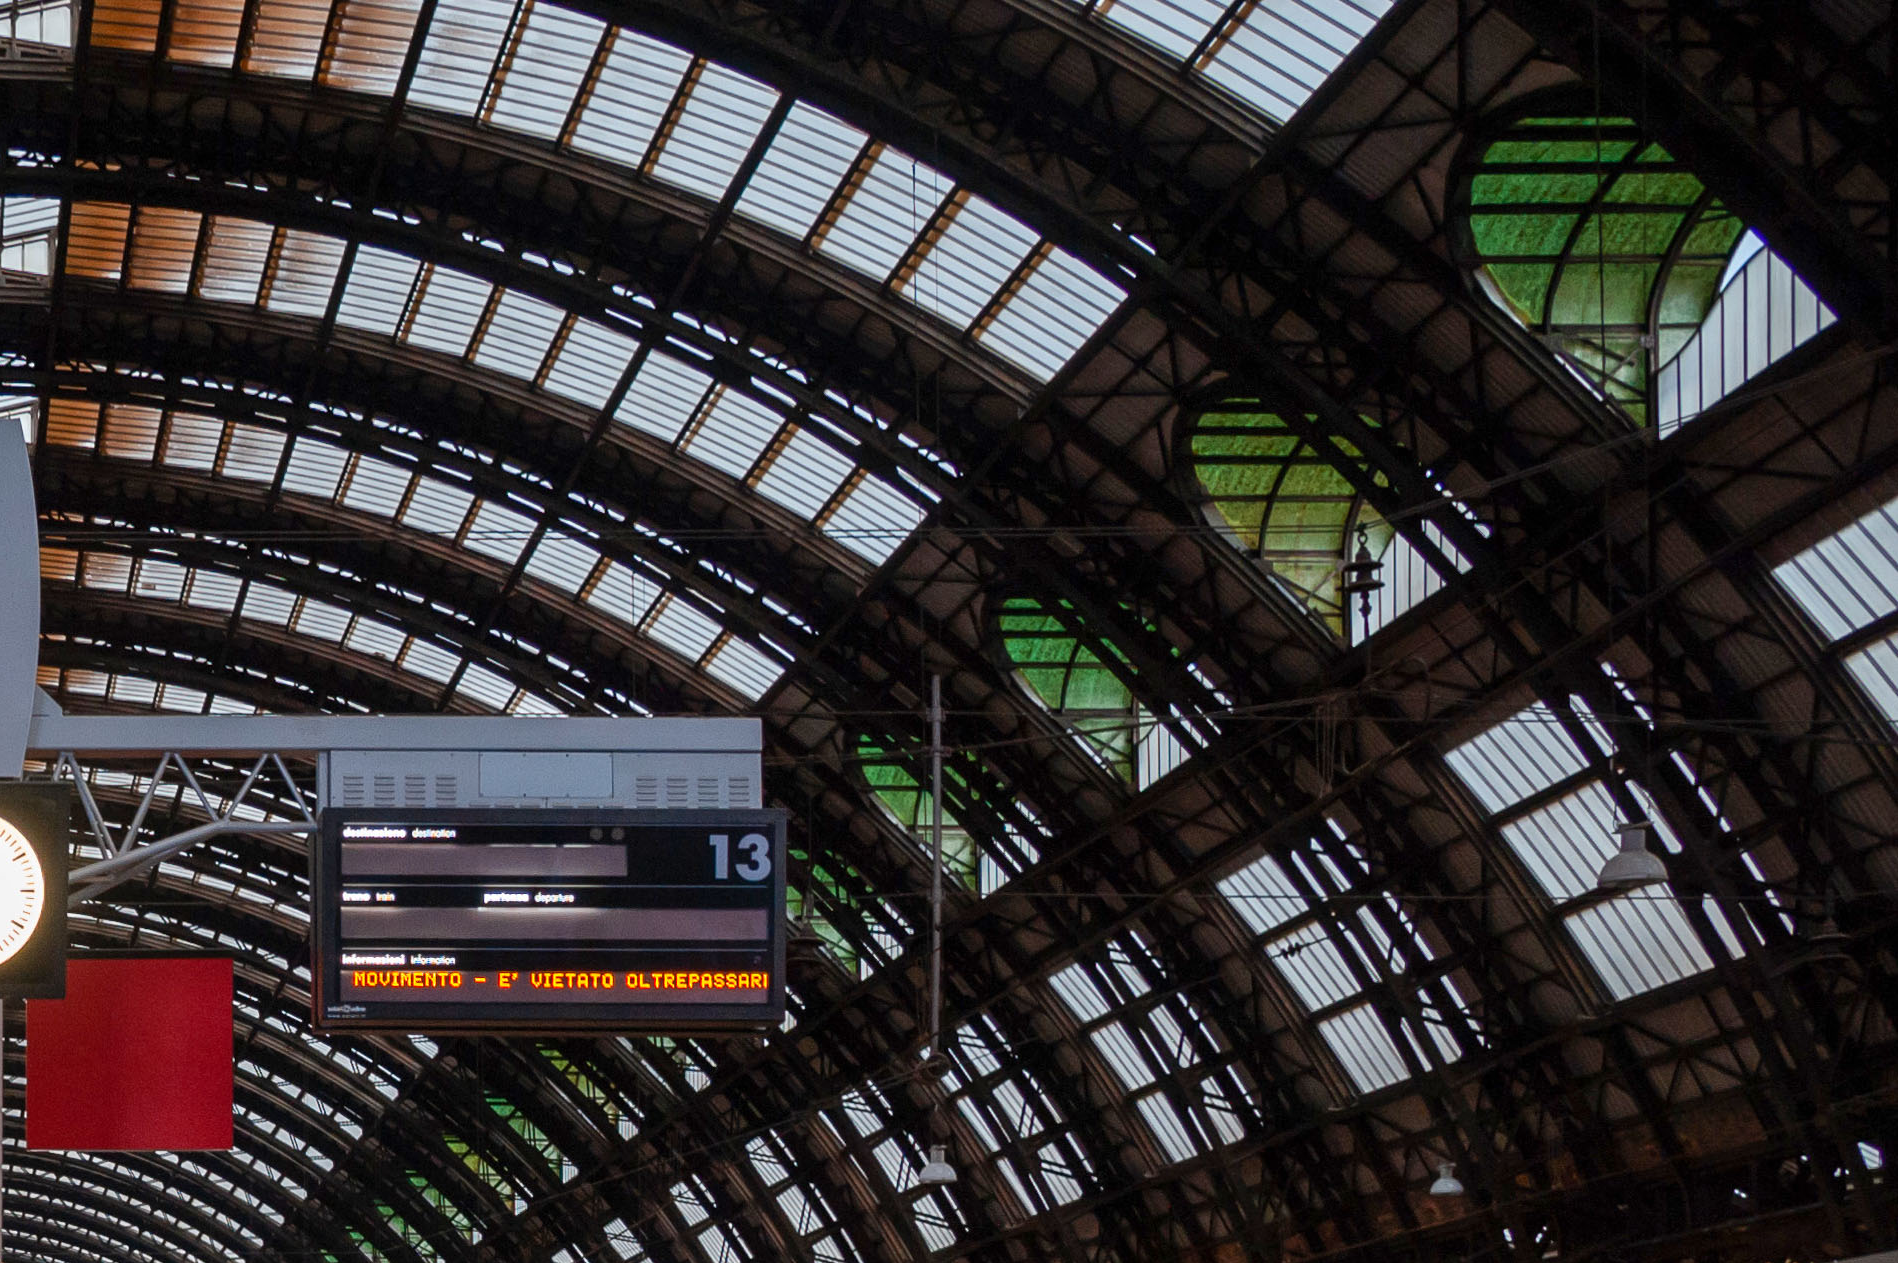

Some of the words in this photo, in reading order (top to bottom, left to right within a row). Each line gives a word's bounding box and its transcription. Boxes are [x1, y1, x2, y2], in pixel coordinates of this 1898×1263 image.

[412, 827, 456, 839] destination
[709, 833, 771, 880] 13
[376, 891, 395, 902] train
[534, 891, 574, 904] departure
[410, 954, 455, 966] information
[353, 971, 462, 988] MOVIMENTO
[531, 971, 614, 989] VIETATO
